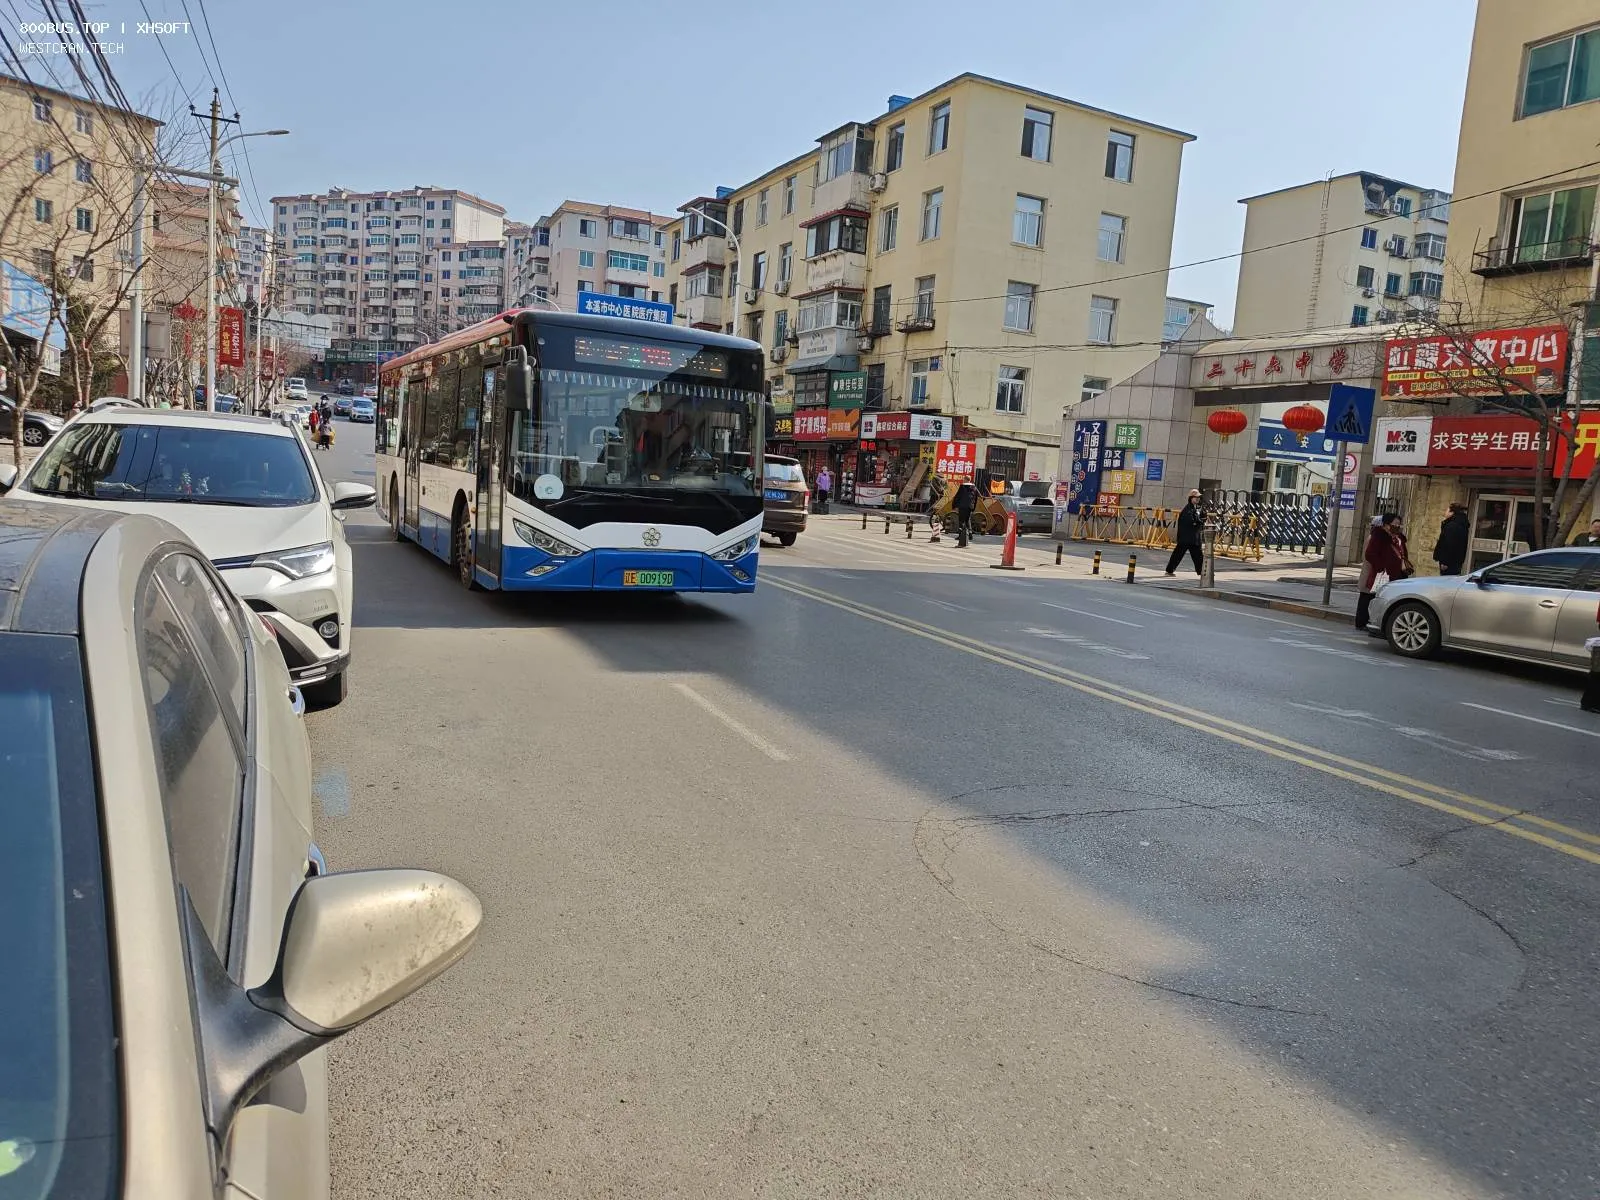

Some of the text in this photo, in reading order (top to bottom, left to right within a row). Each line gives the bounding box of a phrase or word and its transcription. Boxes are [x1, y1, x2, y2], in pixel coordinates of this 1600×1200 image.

[585, 299, 668, 323] 本溪市中心医院医疗集团
[1387, 431, 1417, 443] M&G
[1432, 431, 1550, 451] 求实学生用品
[1087, 422, 1101, 473] 文明城市
[937, 459, 973, 475] 综合超市
